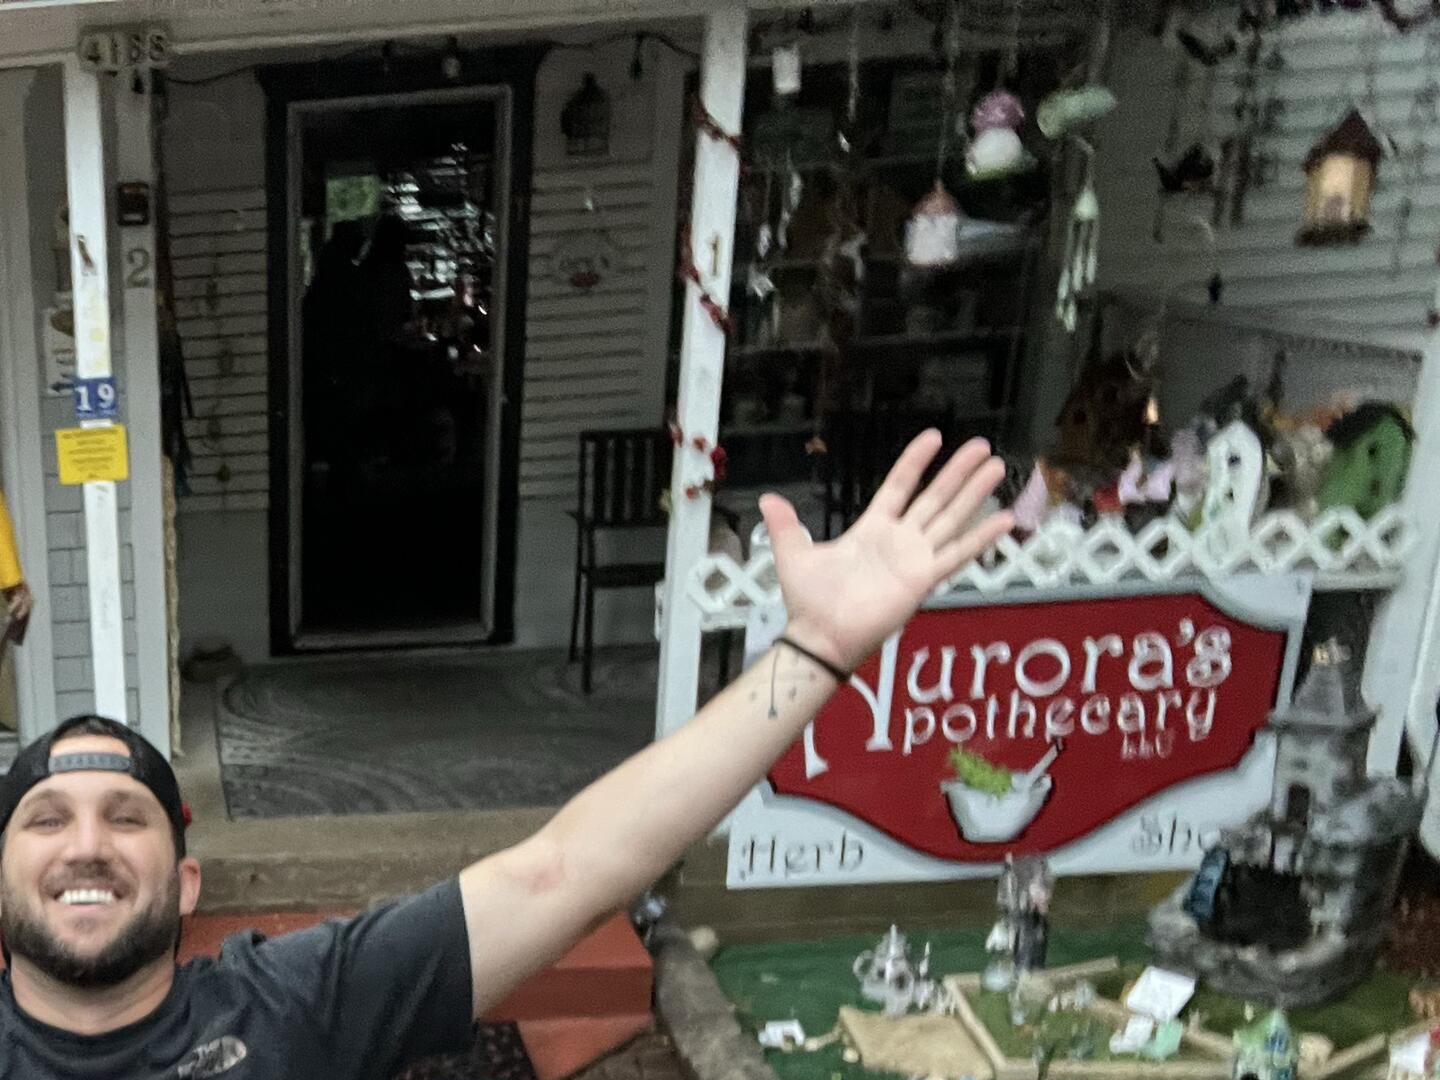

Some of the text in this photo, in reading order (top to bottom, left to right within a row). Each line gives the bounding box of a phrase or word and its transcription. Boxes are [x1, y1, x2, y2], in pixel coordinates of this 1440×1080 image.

[127, 248, 150, 288] 2
[75, 383, 115, 412] 19
[739, 830, 864, 880] Herb
